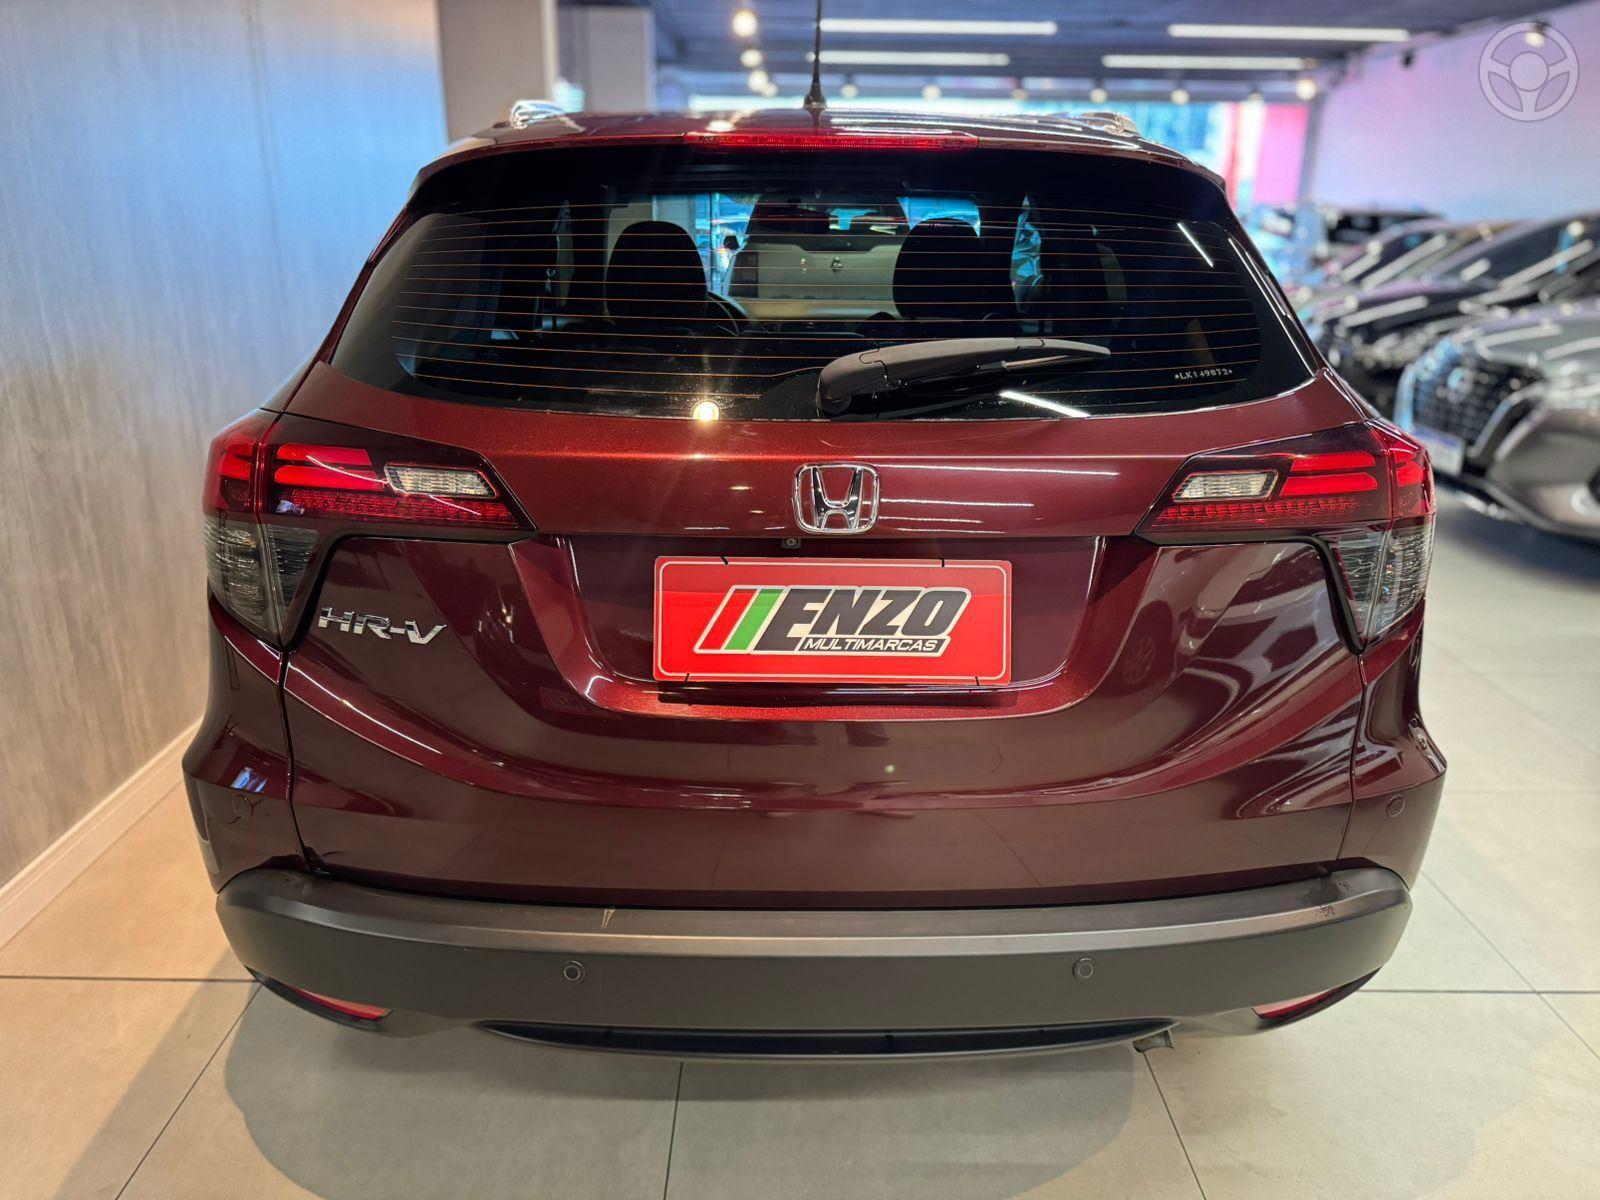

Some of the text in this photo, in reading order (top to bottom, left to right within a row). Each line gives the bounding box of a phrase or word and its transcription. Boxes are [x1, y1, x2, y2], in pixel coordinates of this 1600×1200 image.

[318, 607, 447, 645] HR-V
[753, 587, 970, 651] ENZO
[803, 637, 939, 652] MULTIMARCAS
